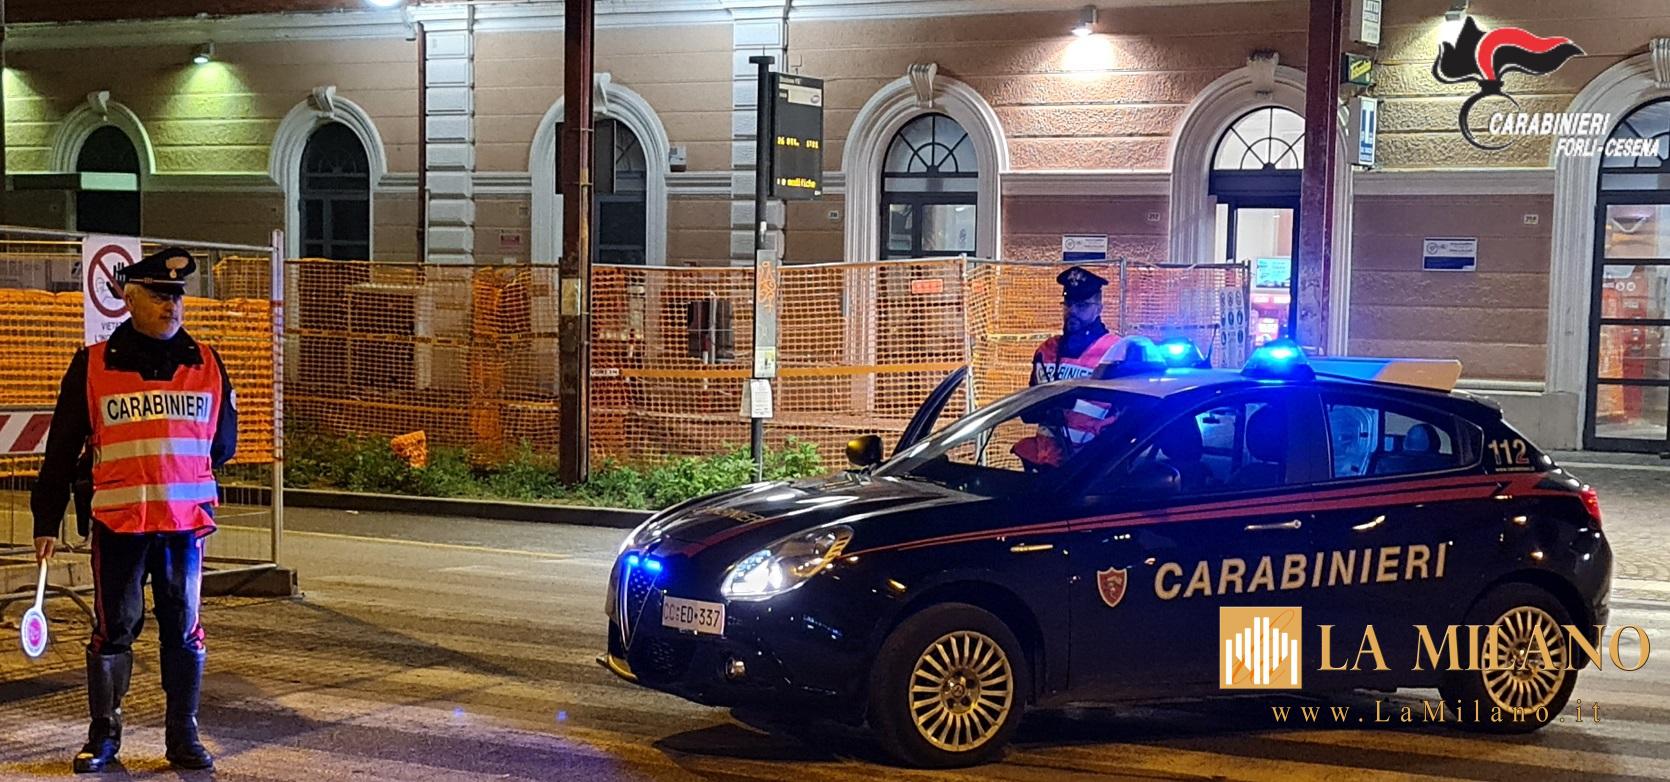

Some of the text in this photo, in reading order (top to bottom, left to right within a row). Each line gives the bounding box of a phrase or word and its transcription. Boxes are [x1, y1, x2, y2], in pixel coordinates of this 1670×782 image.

[107, 394, 208, 420] CARABINIERI
[1488, 438, 1530, 465] 112
[1154, 543, 1447, 600] CARABINIERI
